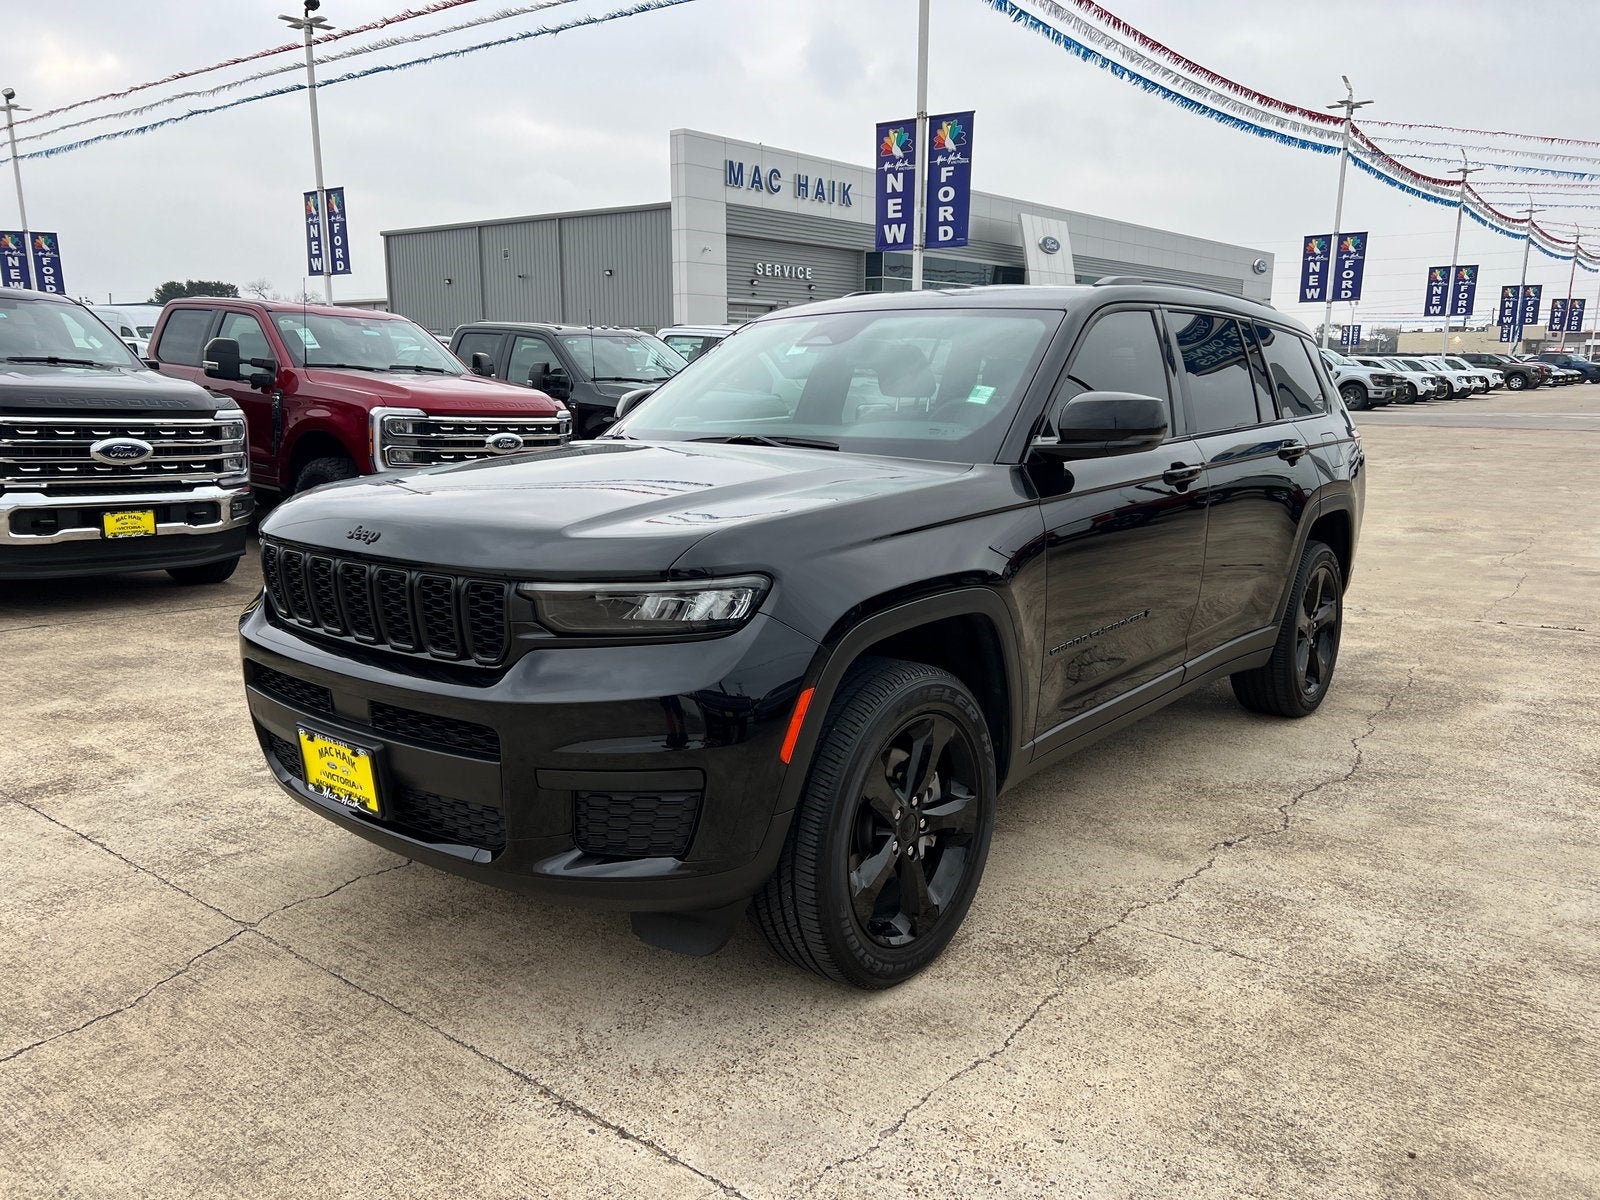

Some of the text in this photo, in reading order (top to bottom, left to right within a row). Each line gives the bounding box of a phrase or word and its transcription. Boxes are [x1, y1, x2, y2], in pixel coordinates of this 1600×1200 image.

[727, 159, 853, 207] MAC HAIK
[883, 172, 907, 244] NEW
[937, 166, 956, 242] FORD
[309, 224, 322, 271] NEW
[333, 223, 345, 271] FORD
[7, 256, 24, 290] NEW
[42, 257, 57, 293] FORD
[756, 262, 813, 280] SERVICE
[1305, 261, 1321, 299] NEW
[1340, 260, 1355, 299] FORD
[1429, 286, 1442, 314] NEW
[1457, 285, 1469, 314] FORD
[1502, 301, 1513, 324] NEW
[1525, 300, 1535, 324] FORD
[1551, 311, 1561, 330] NEW
[1570, 311, 1578, 330] FORD
[25, 397, 191, 409] SUPER DUTY
[110, 445, 139, 458] Ford
[498, 438, 516, 449] Ford
[345, 525, 381, 545] Jeep
[318, 747, 357, 773] MAC HAIK
[325, 771, 357, 790] VICTORIA
[321, 786, 361, 808] Mac Haik
